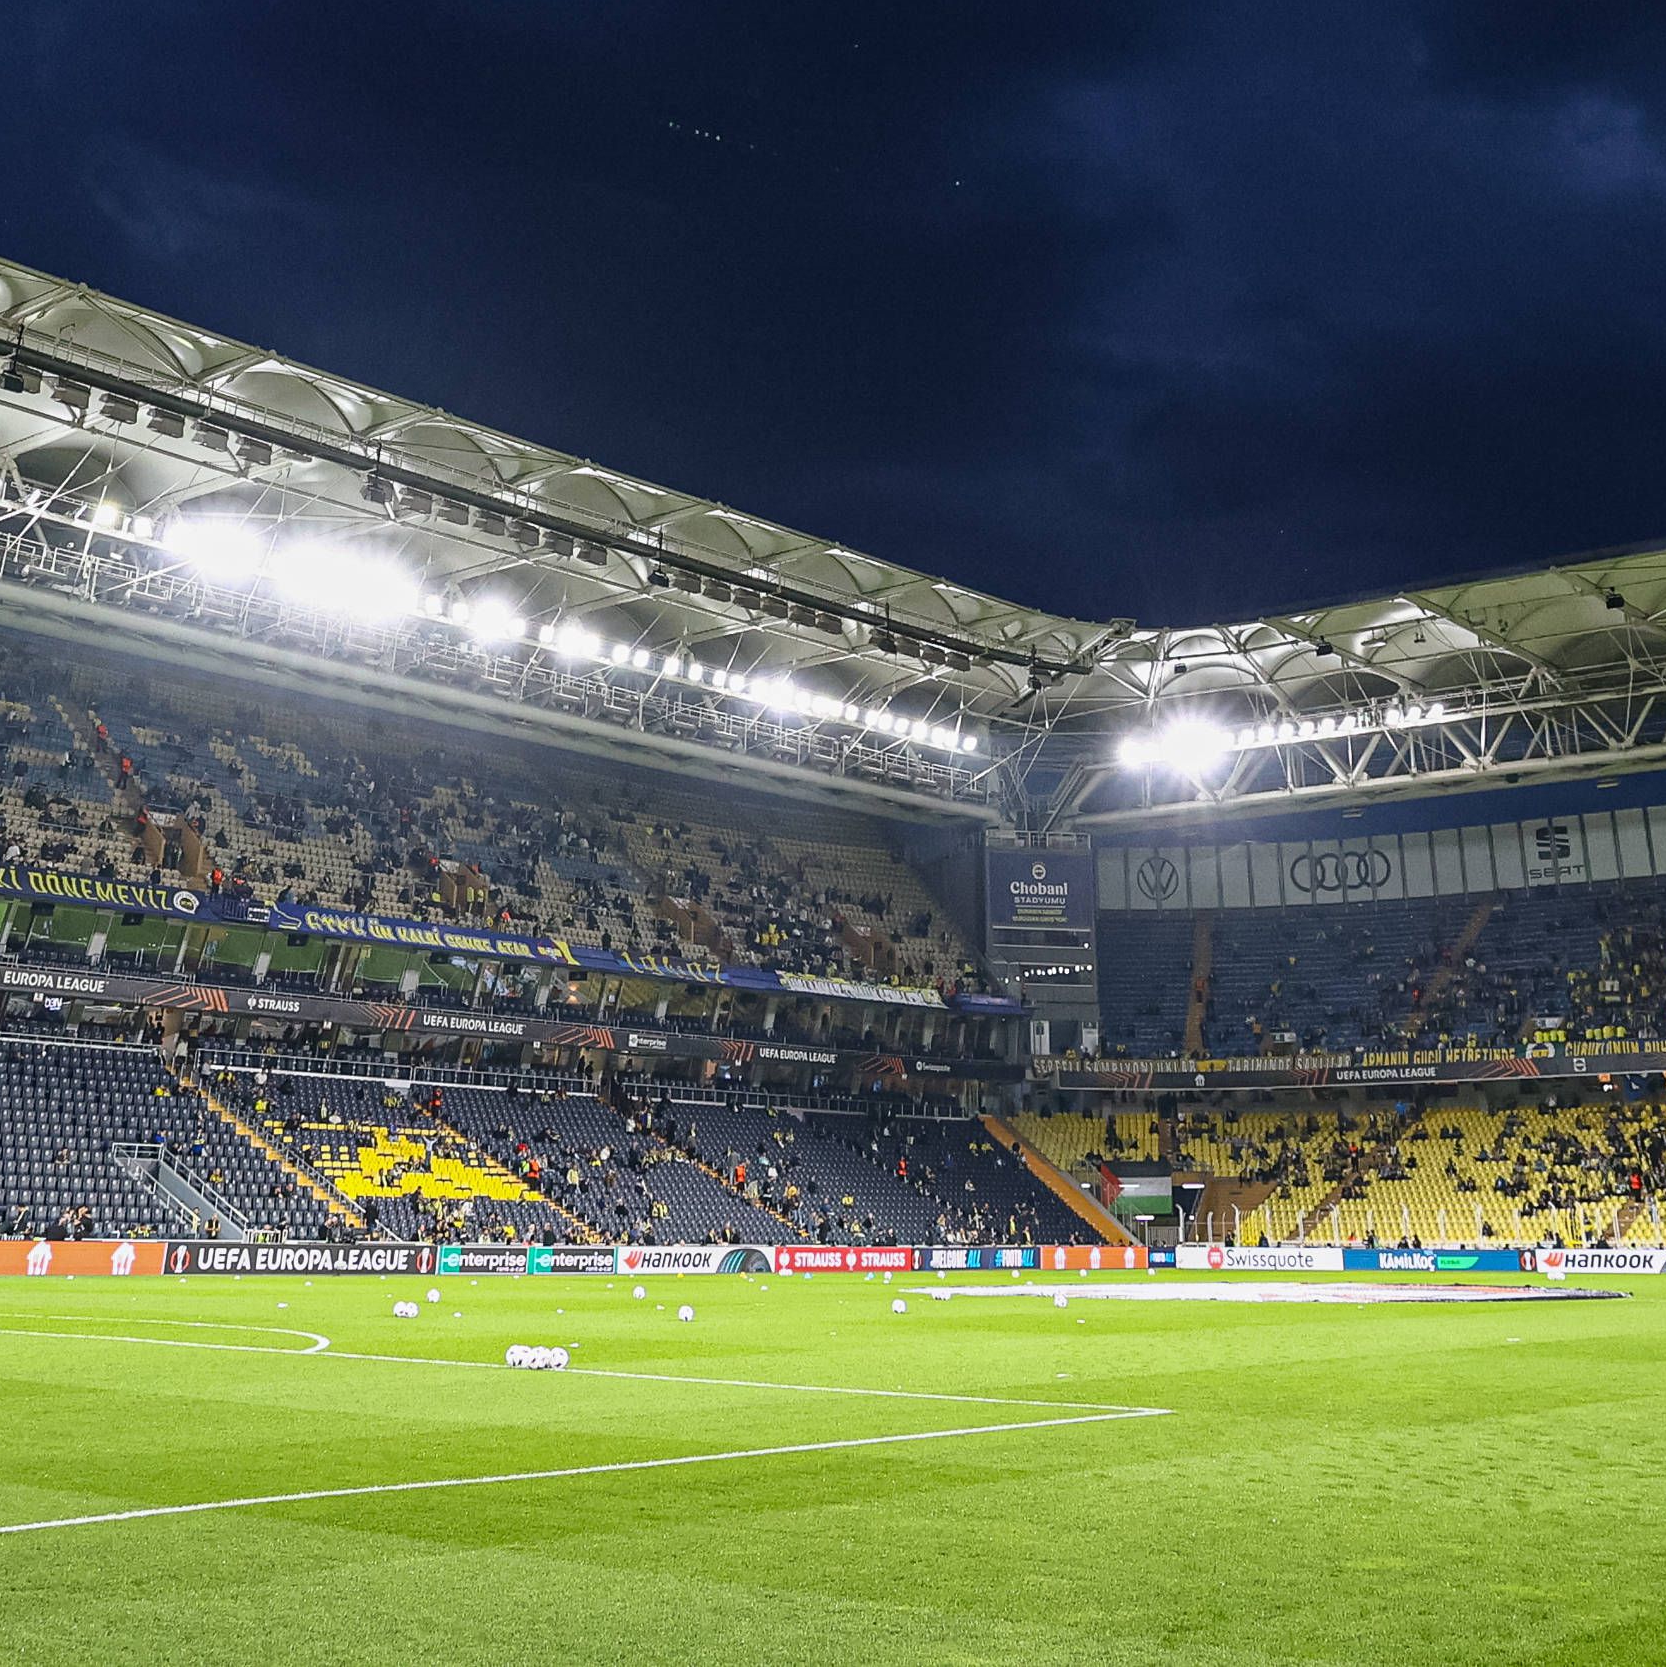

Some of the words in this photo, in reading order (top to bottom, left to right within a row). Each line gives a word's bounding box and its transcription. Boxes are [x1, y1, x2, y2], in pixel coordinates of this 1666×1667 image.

[1529, 864, 1585, 880] SEAT
[30, 870, 173, 911] DÖNEMEYİZ
[1010, 881, 1068, 895] Chobani
[4, 970, 53, 989] EUROPA
[56, 976, 106, 994] LEAGUE
[258, 999, 300, 1013] STRAUSS
[423, 1014, 448, 1027] UEFA
[450, 1016, 486, 1032] EUROPA
[488, 1020, 525, 1034] LEAGUE
[760, 1047, 779, 1059] UEFA
[780, 1049, 808, 1061] EUROPA
[809, 1052, 837, 1063] LEAGUE
[1337, 1069, 1361, 1081] UEFA
[1362, 1068, 1398, 1080] EUROPA
[1399, 1066, 1436, 1078] LEAGUE
[198, 1247, 251, 1270] UEFA
[255, 1247, 332, 1271] EUROPA
[335, 1248, 409, 1272] LEAGUE
[442, 1246, 527, 1269] enterprise
[536, 1247, 614, 1270] enterprise
[642, 1251, 711, 1268] HANKOOK
[794, 1251, 842, 1268] STRAUSS
[861, 1251, 906, 1267] STRAUSS
[967, 1249, 981, 1267] ALL
[1226, 1248, 1314, 1269] Swissquote
[1564, 1254, 1654, 1270] HANKOOK
